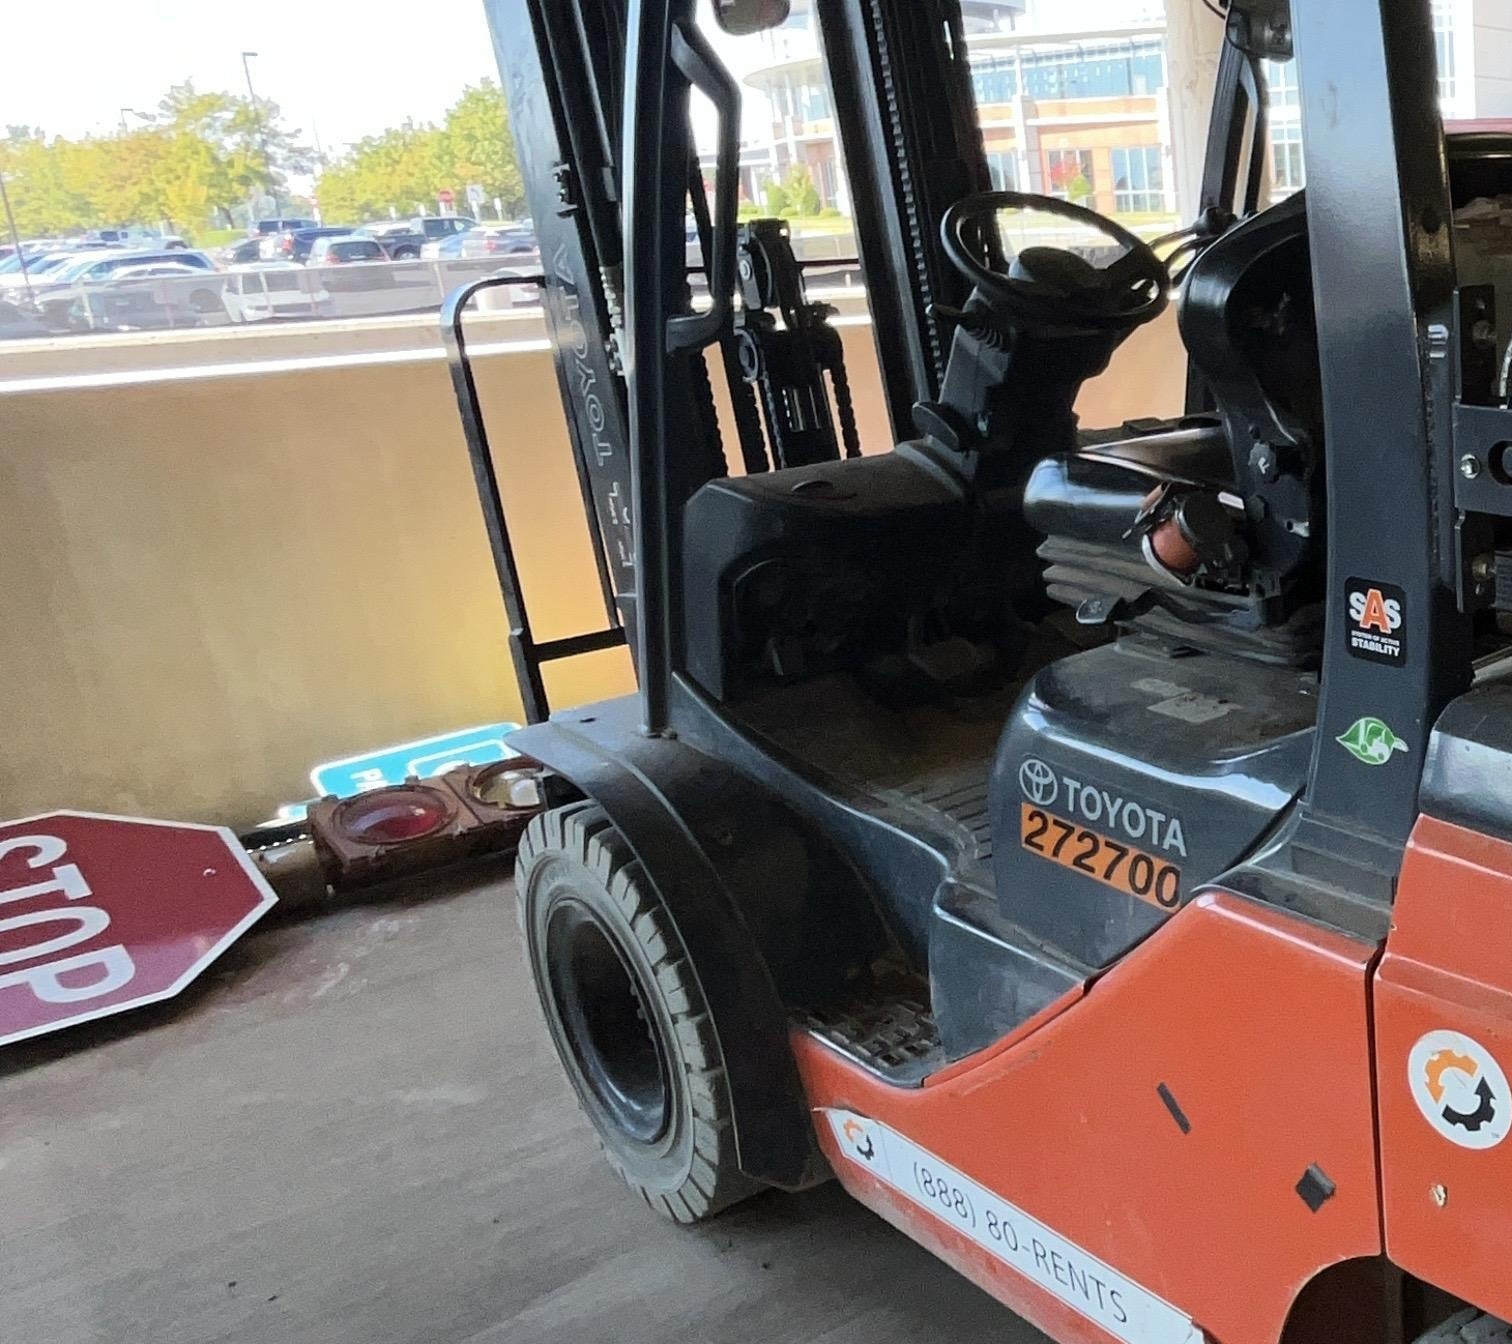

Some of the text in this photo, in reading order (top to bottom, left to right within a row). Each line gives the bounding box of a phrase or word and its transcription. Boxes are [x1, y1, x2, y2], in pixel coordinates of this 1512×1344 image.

[1349, 588, 1402, 635] SAS
[1351, 636, 1400, 657] STABILITY
[1062, 777, 1187, 857] TOYOTA
[1024, 809, 1181, 908] 272700
[913, 1161, 1128, 1324] (888) 80-RENTS
